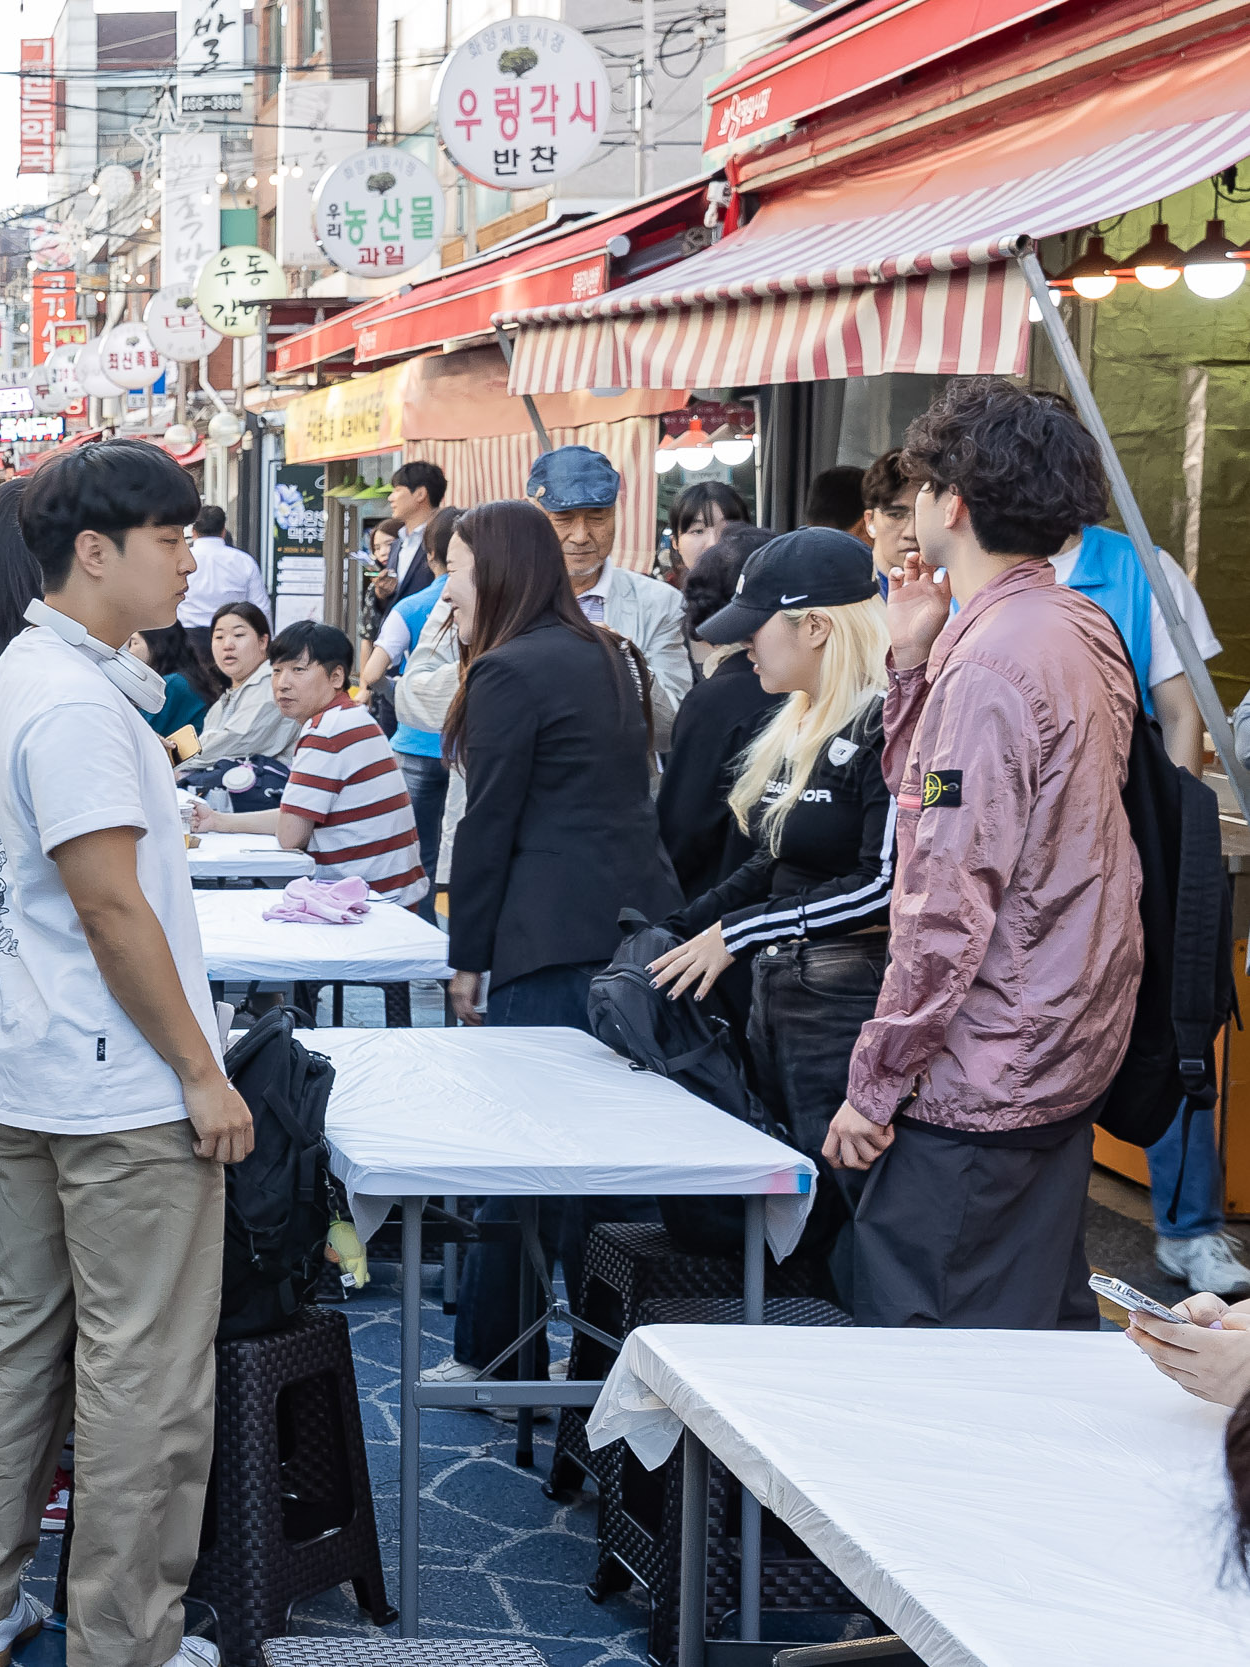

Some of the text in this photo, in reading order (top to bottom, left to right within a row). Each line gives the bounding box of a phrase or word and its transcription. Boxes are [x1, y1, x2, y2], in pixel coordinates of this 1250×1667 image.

[454, 80, 598, 142] 우렁각시
[493, 145, 558, 176] 반찬
[326, 196, 433, 245] 우리 농산물
[214, 254, 270, 287] 우동
[358, 245, 405, 267] 과일
